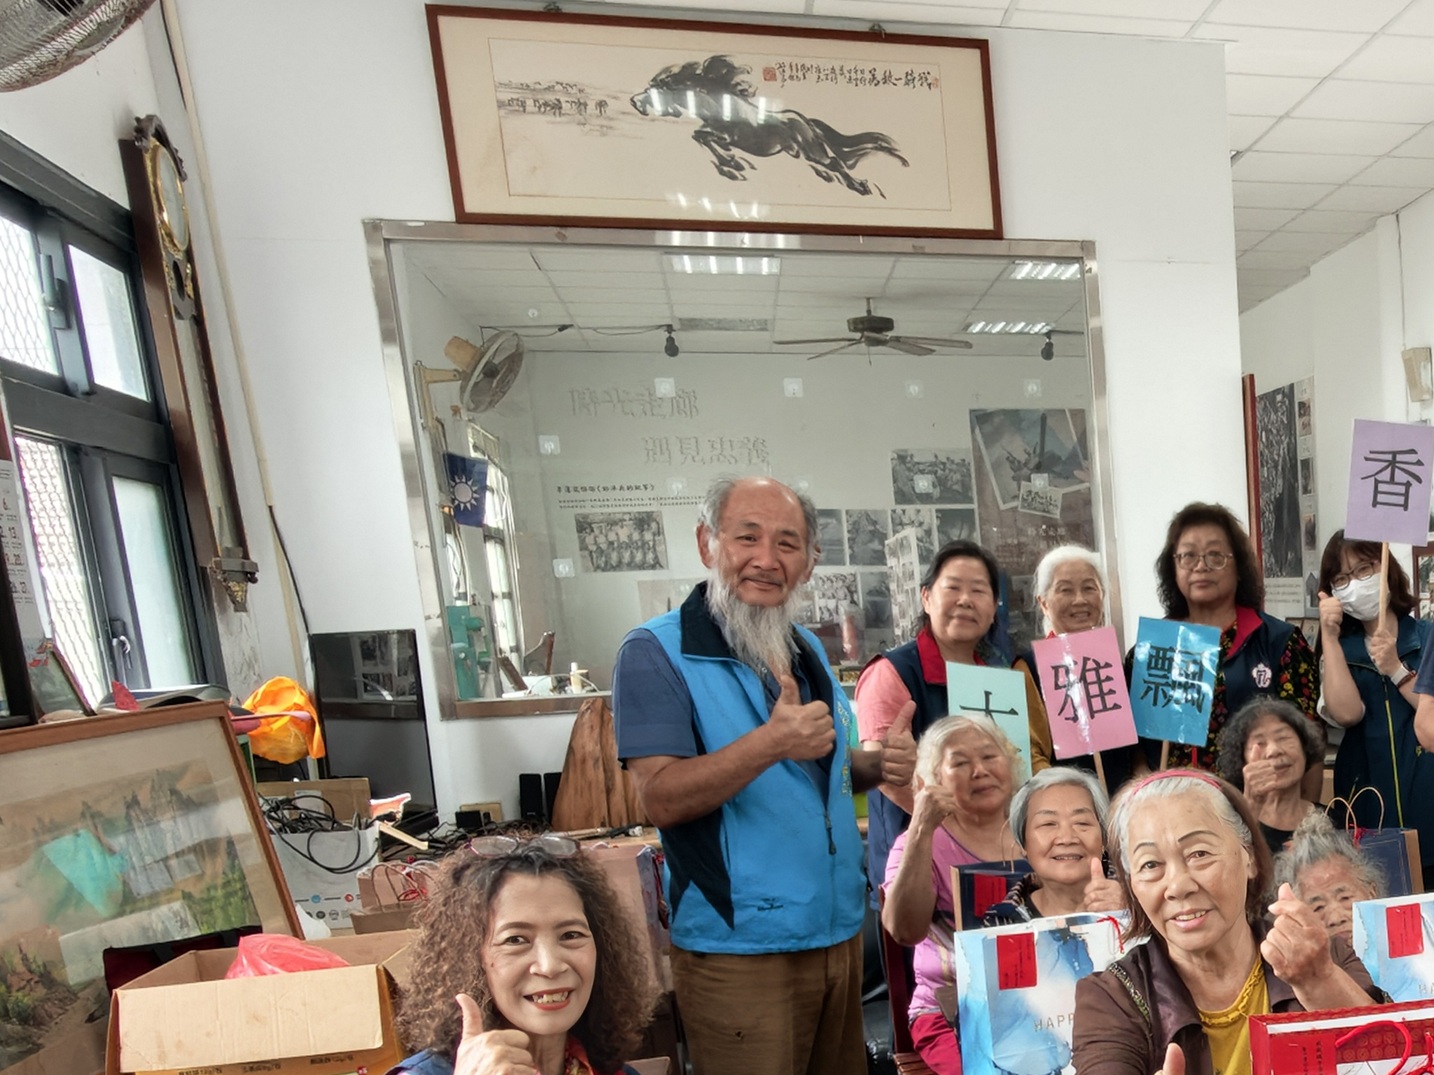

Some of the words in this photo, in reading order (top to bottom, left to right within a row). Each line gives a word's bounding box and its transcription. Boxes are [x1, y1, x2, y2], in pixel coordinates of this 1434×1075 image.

[1361, 448, 1425, 512] 香
[1051, 655, 1122, 724] 雅
[1140, 645, 1204, 715] 飄
[1033, 1012, 1074, 1033] HAPP
